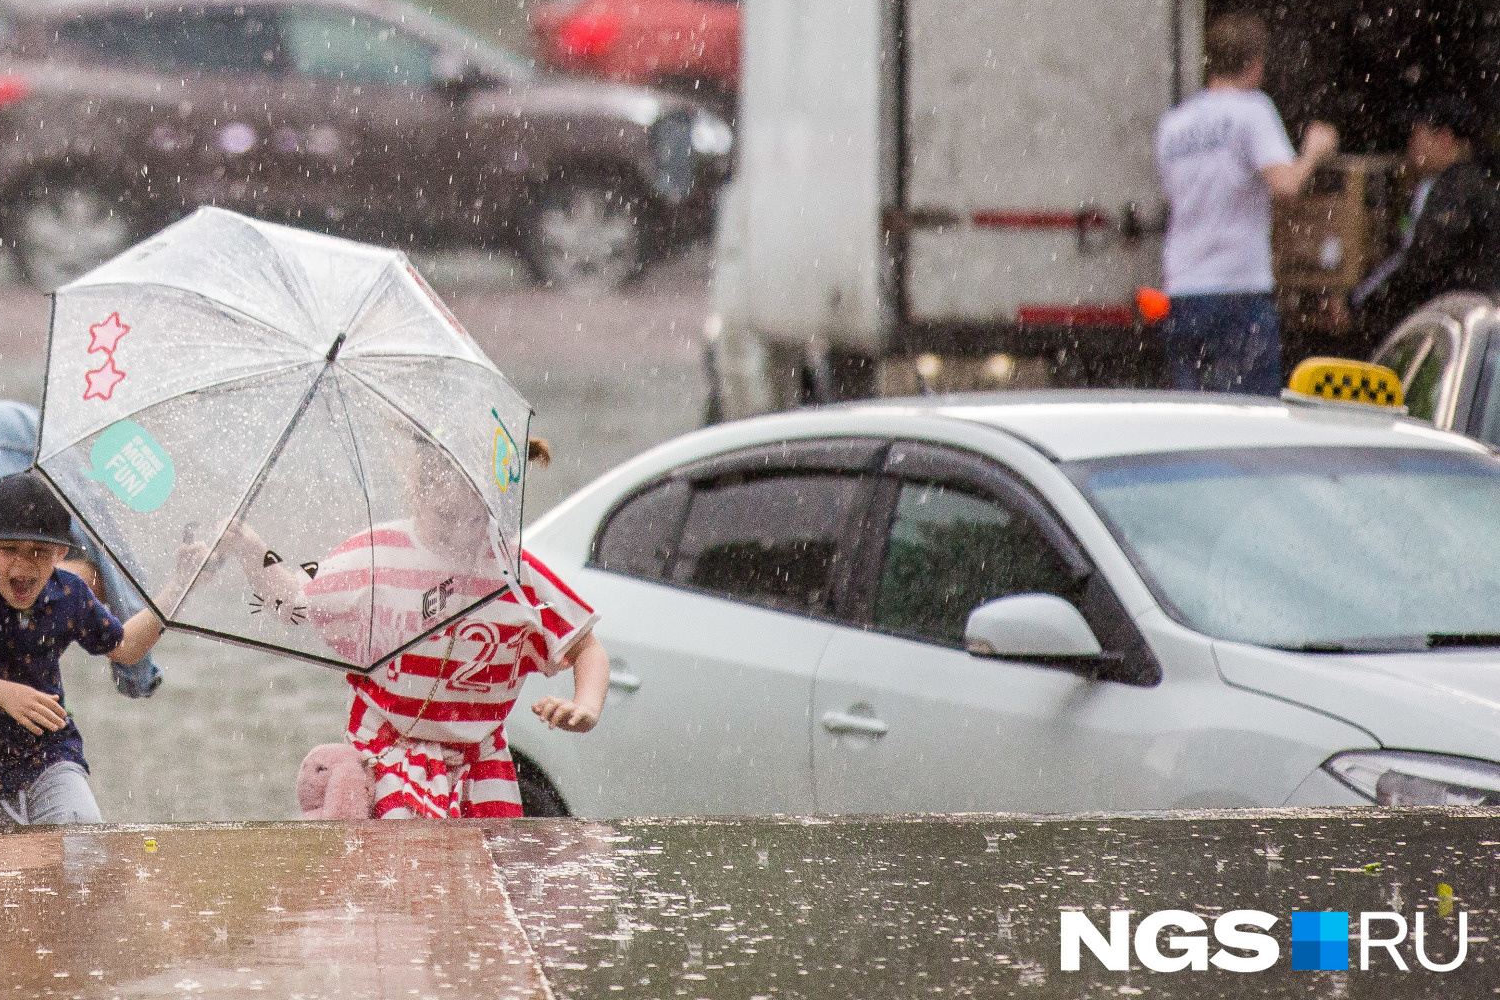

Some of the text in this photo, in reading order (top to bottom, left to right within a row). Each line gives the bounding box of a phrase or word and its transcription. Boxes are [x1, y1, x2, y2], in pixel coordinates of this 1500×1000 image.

[104, 453, 148, 501] FUN!
[121, 441, 158, 483] MORE
[421, 576, 454, 620] EF
